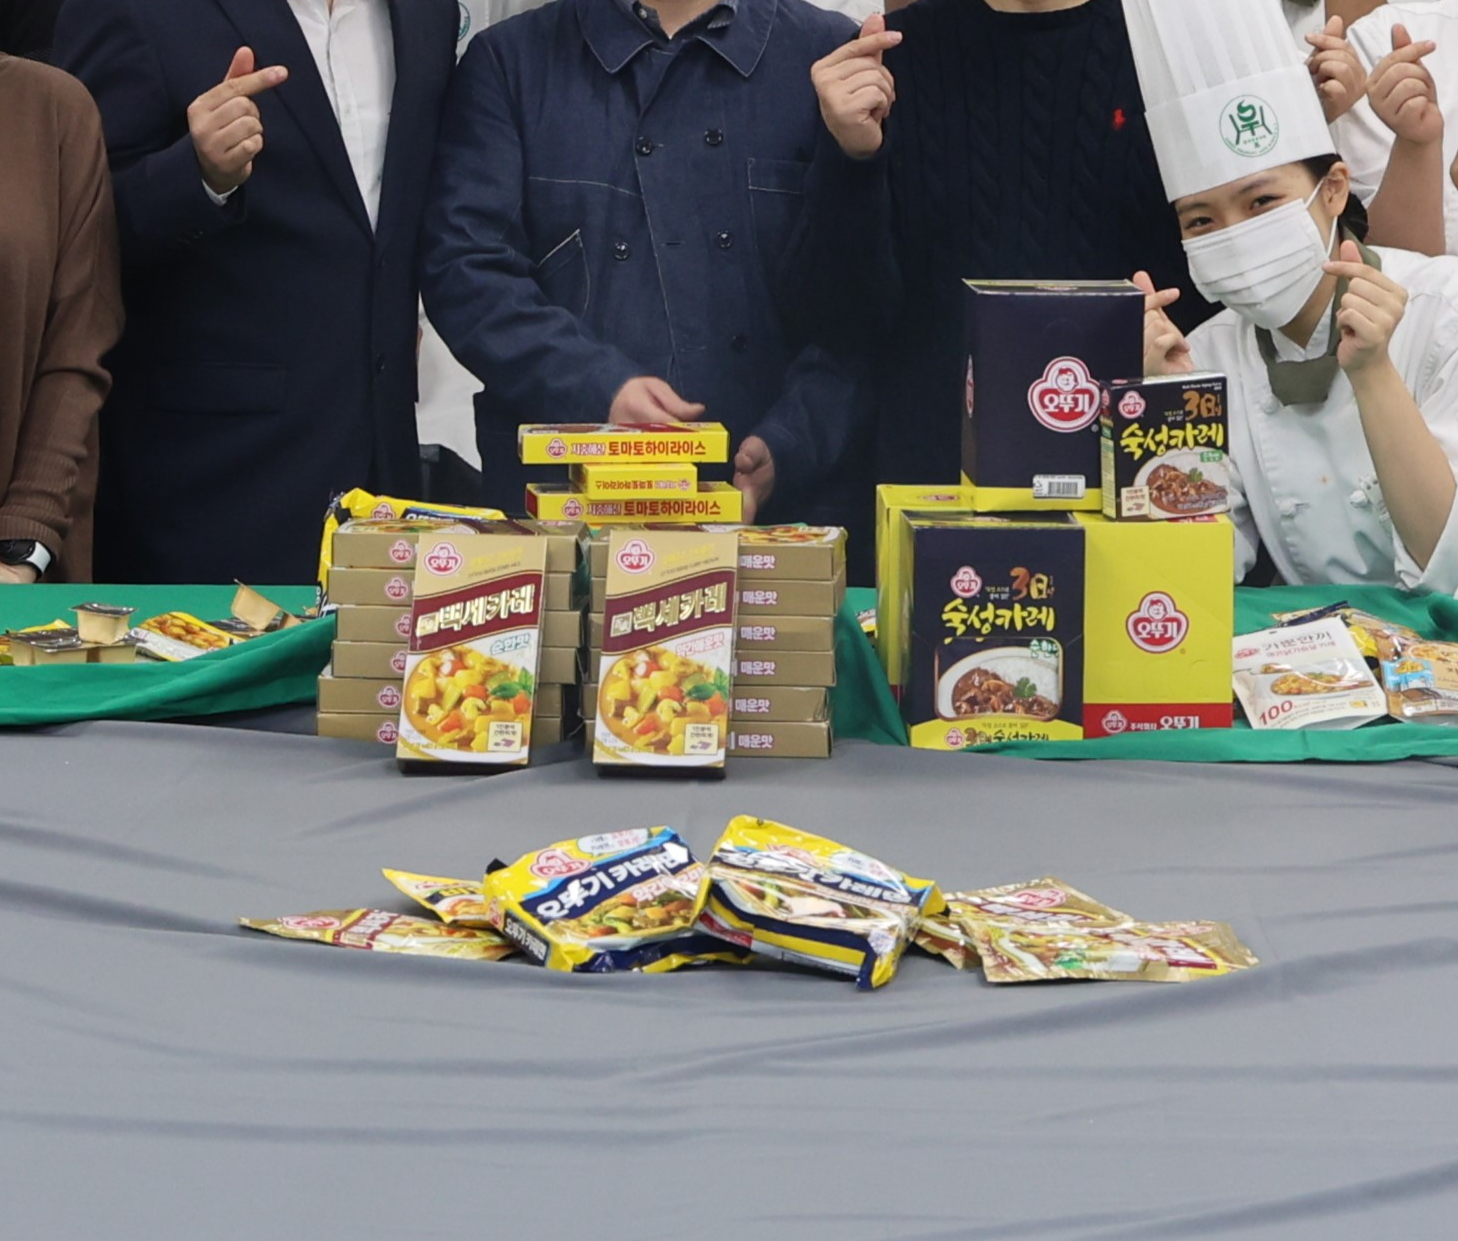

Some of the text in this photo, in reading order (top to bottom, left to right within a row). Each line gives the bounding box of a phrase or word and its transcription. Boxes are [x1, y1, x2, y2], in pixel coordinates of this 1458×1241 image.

[1044, 393, 1090, 413] 오뚜기
[608, 441, 706, 457] 토마토하이라이스
[624, 501, 721, 516] 토마토하이라이스
[428, 559, 458, 570] 오뚜기
[622, 554, 649, 566] 오뚜기
[742, 590, 778, 605] 매운맛
[740, 626, 775, 641] 매운맛
[1137, 621, 1178, 639] 오뚜기
[740, 661, 775, 675] 매운맛
[735, 698, 770, 713] 매운맛
[1258, 700, 1294, 726] 100
[1160, 715, 1200, 730] 오뚜기
[738, 734, 773, 749] 매운맛
[536, 871, 616, 919] 오뚜기
